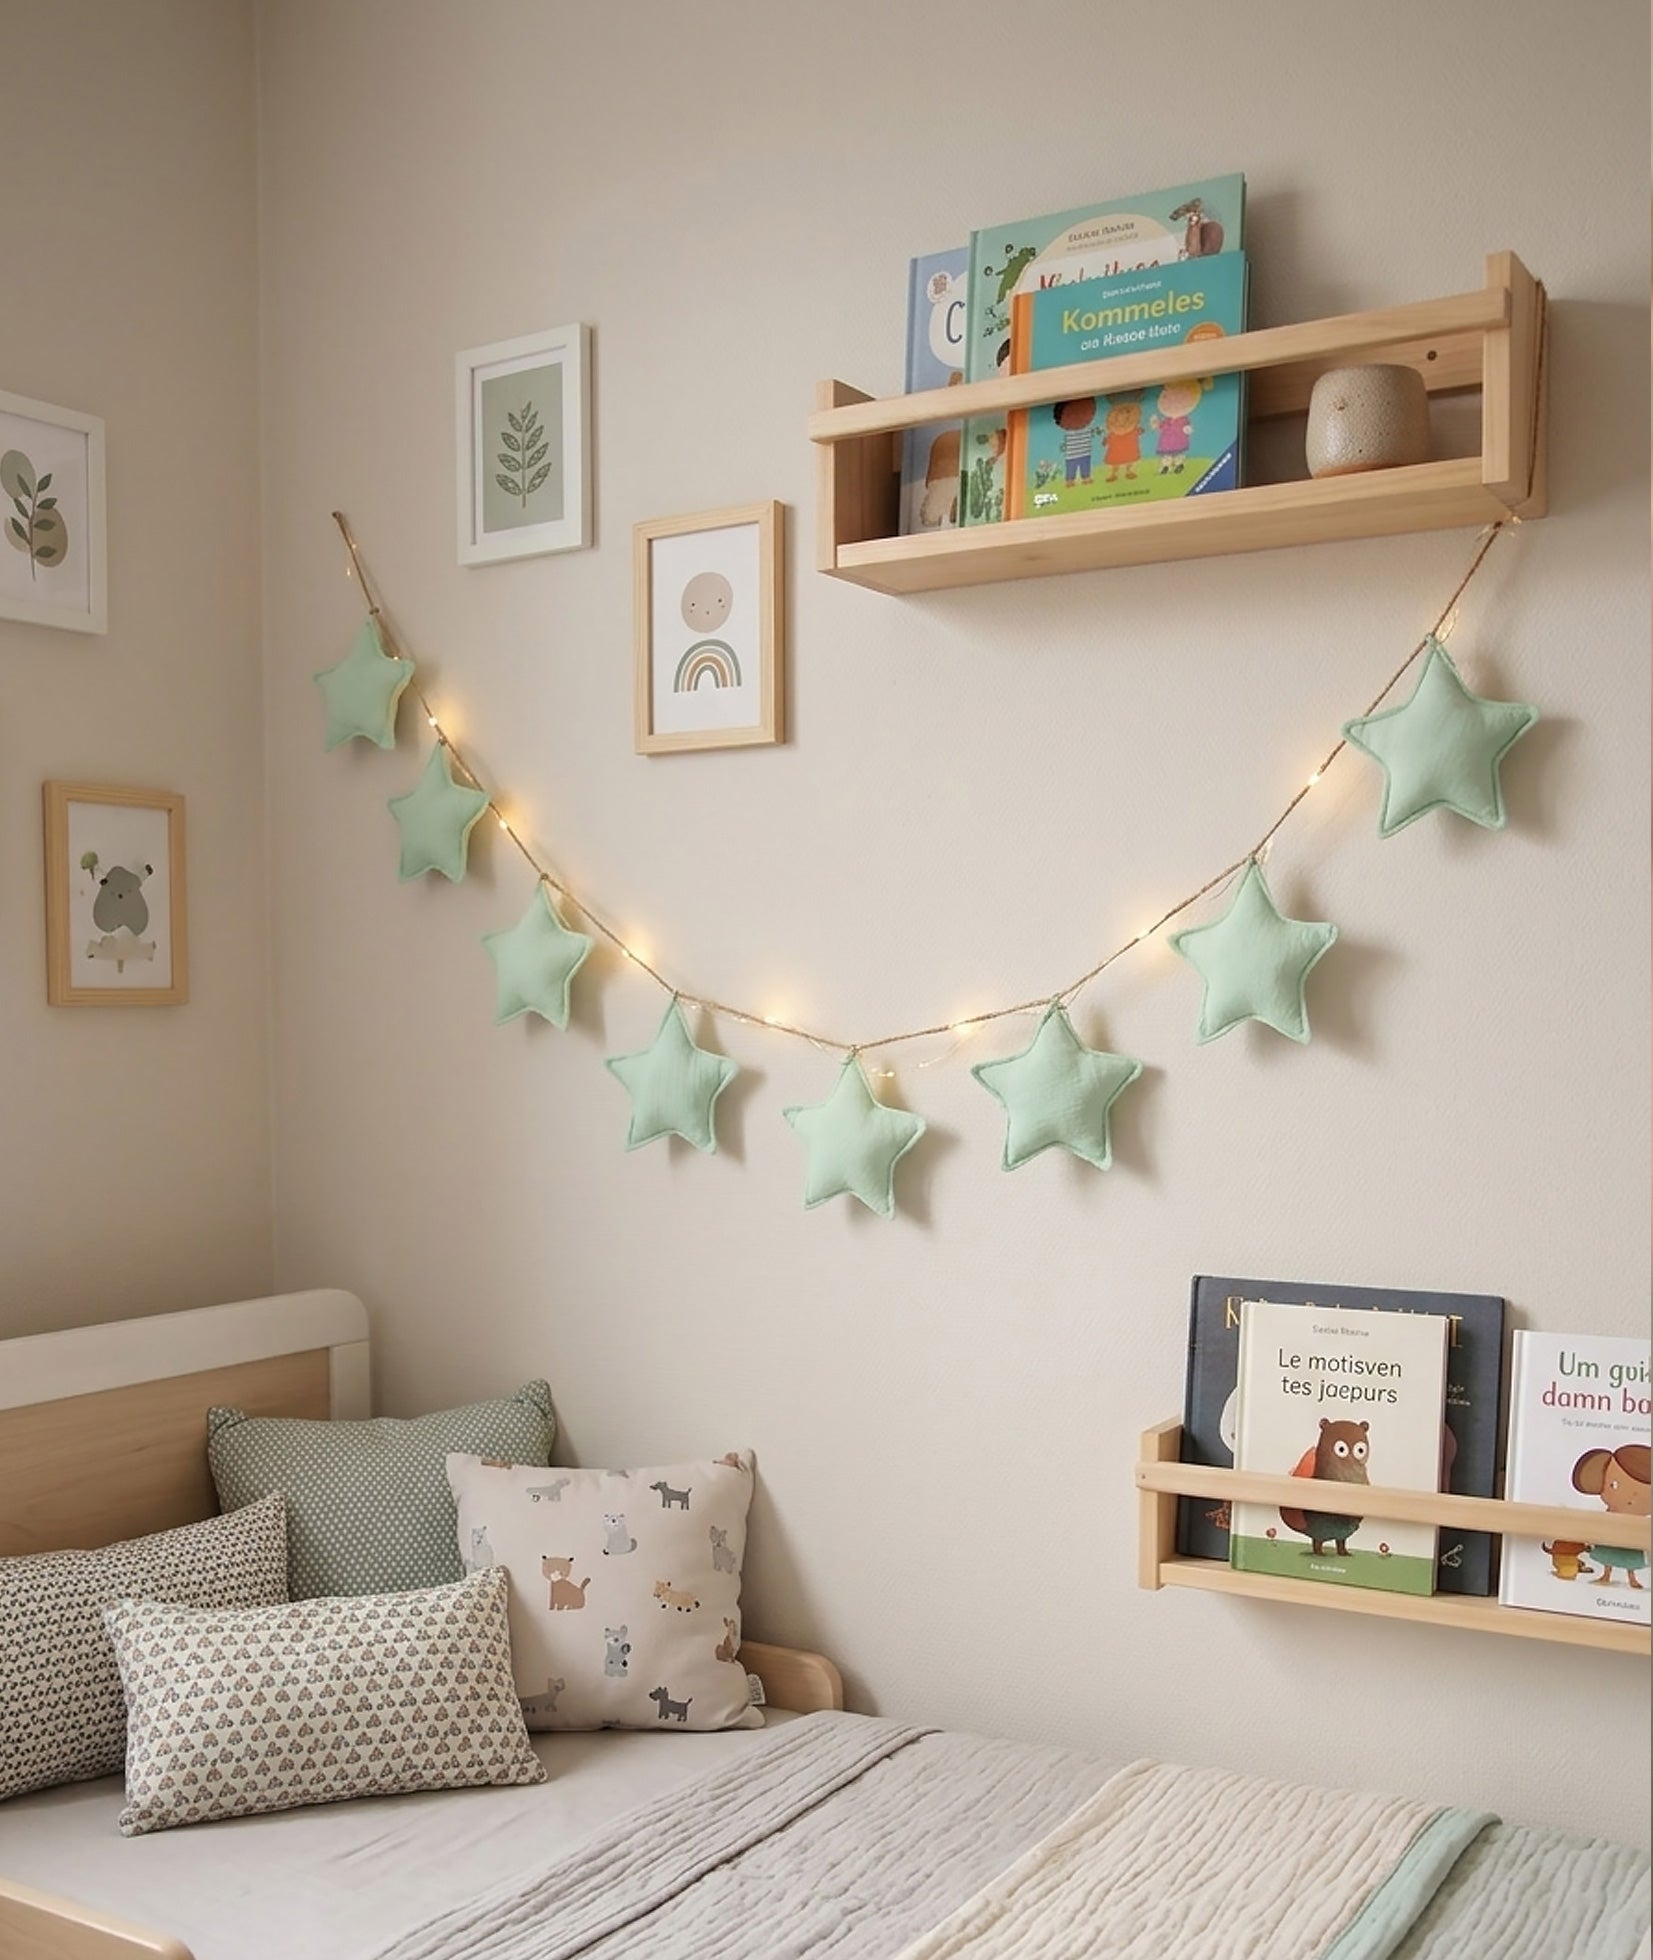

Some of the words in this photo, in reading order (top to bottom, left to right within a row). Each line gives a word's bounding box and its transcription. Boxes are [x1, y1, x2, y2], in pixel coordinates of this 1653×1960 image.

[1062, 290, 1205, 334] Kommeles
[1278, 1348, 1301, 1369] Le
[1308, 1354, 1402, 1378] motisven
[1559, 1350, 1600, 1379] Um
[1281, 1376, 1313, 1396] tes
[1317, 1379, 1398, 1404] jaepurs
[1542, 1380, 1611, 1412] damn
